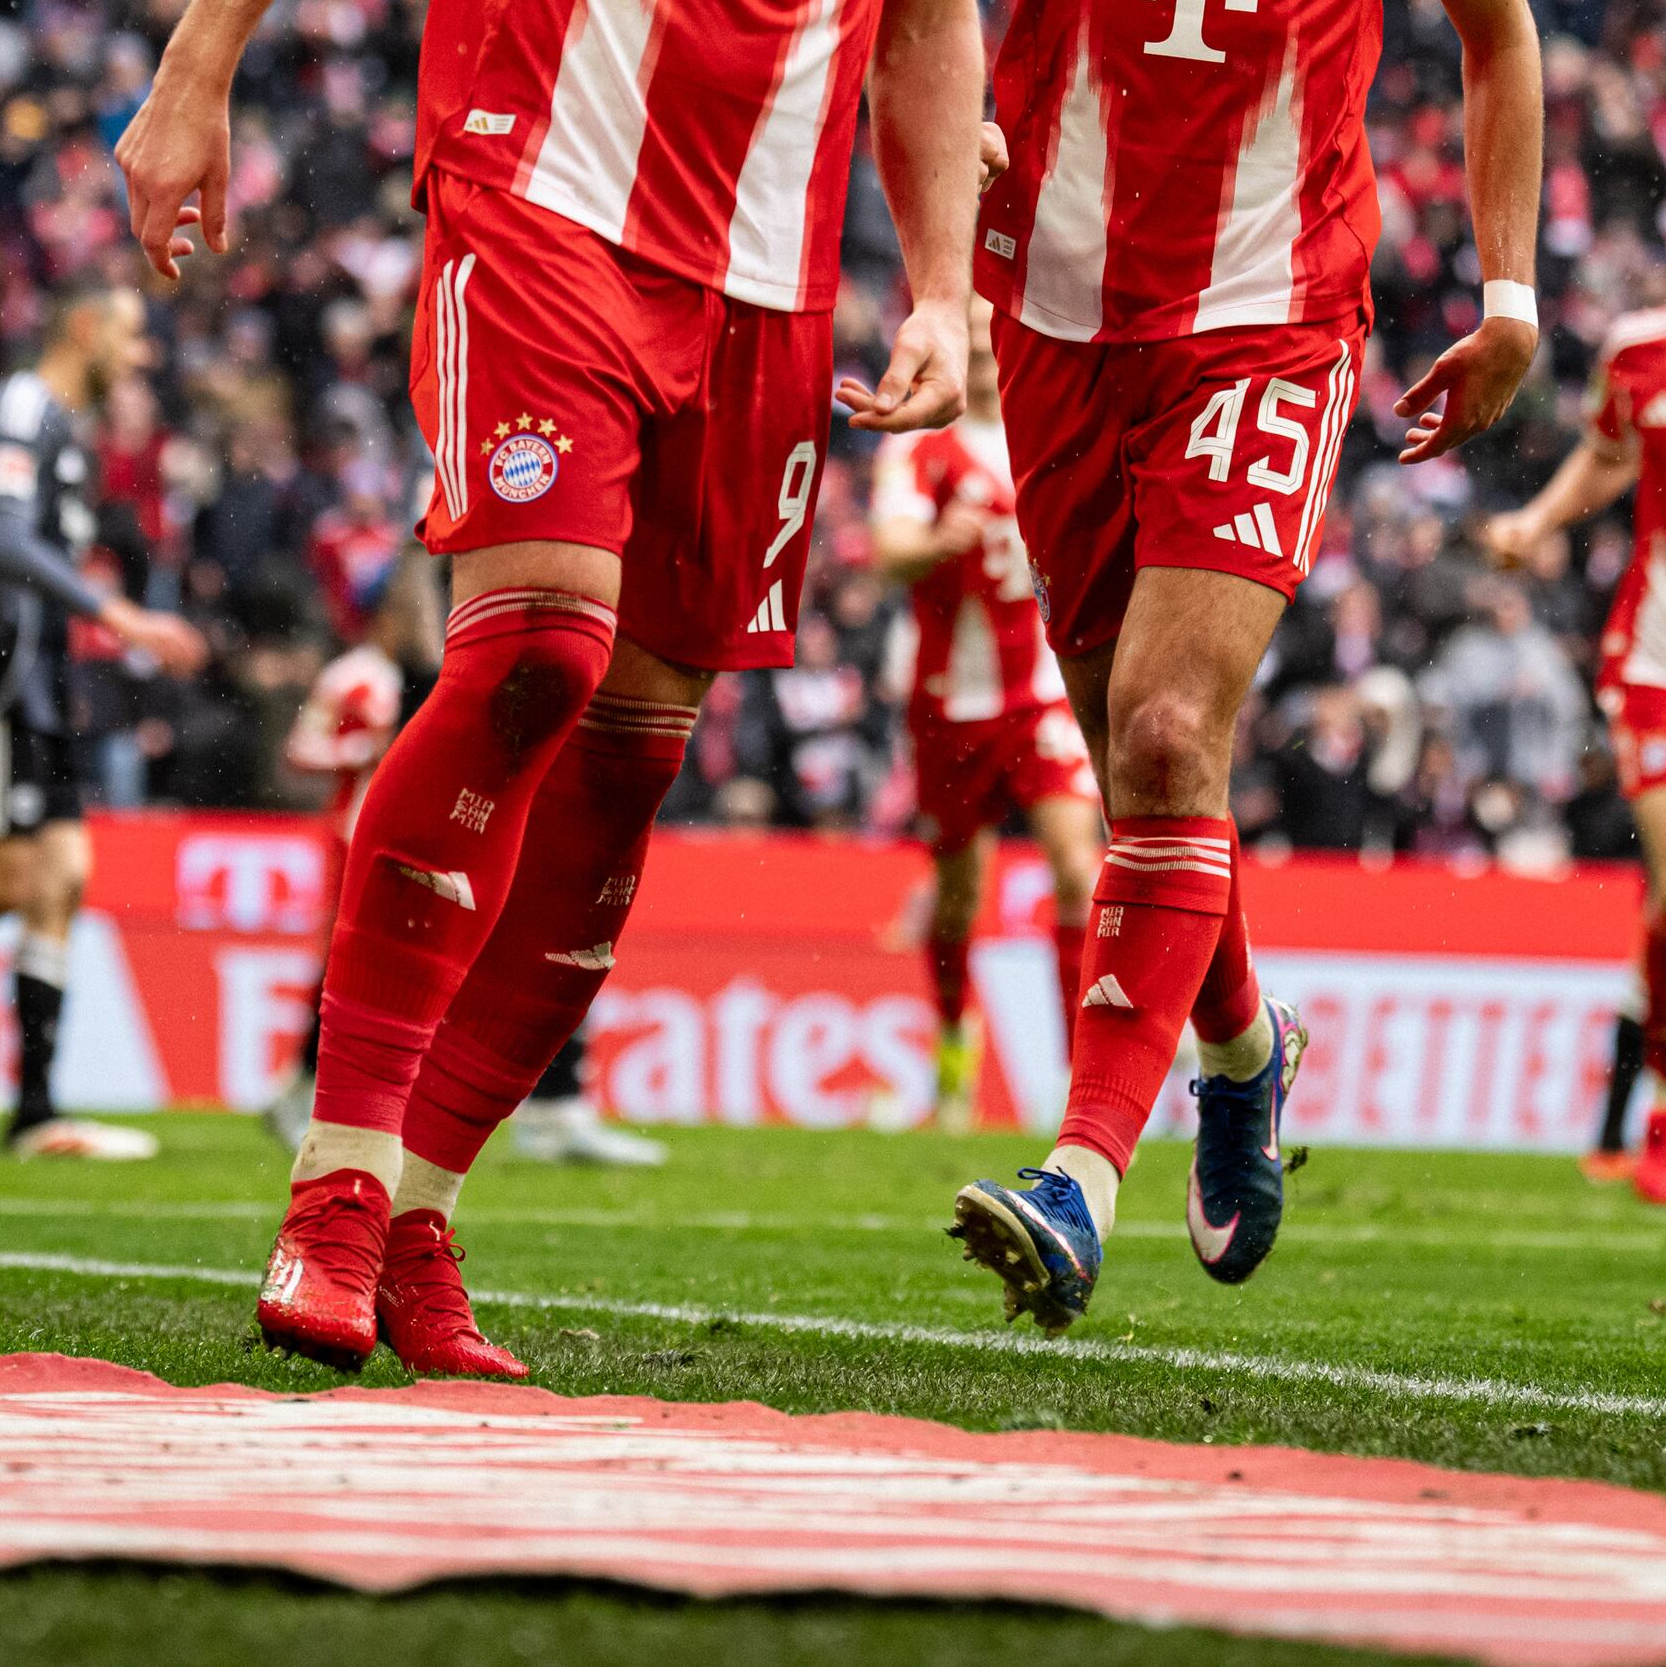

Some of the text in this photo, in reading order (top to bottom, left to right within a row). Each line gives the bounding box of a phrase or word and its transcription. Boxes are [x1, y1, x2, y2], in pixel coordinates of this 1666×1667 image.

[1184, 377, 1316, 496] 45
[508, 439, 552, 465] BAYERN
[764, 439, 818, 569] 9
[459, 787, 496, 812] MIA
[449, 810, 486, 835] MIA
[1099, 916, 1122, 927] SAN
[1101, 906, 1124, 919] MIA
[1097, 926, 1120, 938] MIA
[215, 944, 939, 1129] Eates
